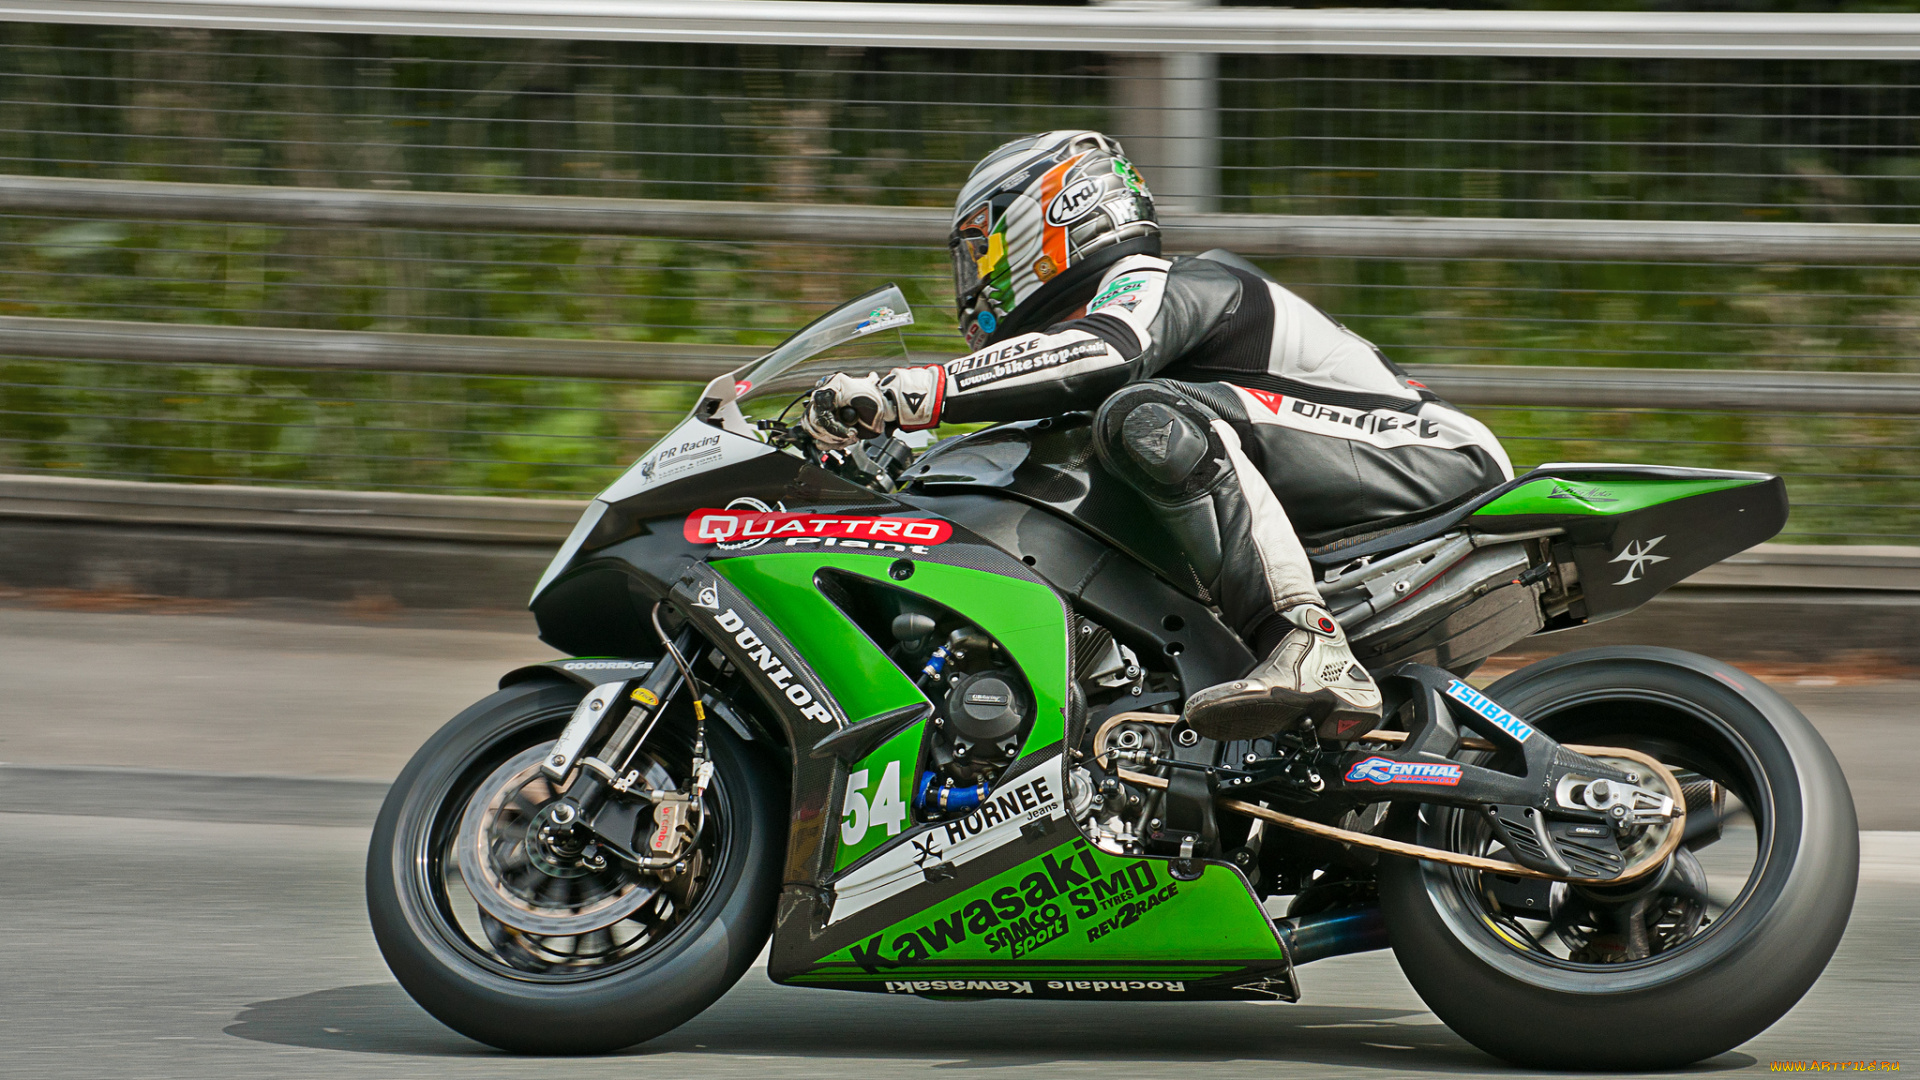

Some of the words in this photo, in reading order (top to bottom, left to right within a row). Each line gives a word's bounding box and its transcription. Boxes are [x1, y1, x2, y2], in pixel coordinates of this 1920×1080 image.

[1057, 180, 1099, 221] Arai
[960, 341, 1105, 387] www.bikestop.co.uk
[659, 447, 677, 460] PR
[680, 435, 721, 453] Racing
[698, 515, 940, 542] QUATTRO
[563, 661, 654, 671] GOODRIDGE
[714, 608, 833, 724] DUNLOP
[1448, 679, 1533, 741] TSUBAKI
[1352, 759, 1460, 781] RENTHAL
[841, 760, 906, 846] 54
[944, 776, 1054, 845] HORNEE
[1027, 802, 1059, 820] Jeans
[849, 839, 1102, 975] Kawasaki
[1068, 860, 1157, 920] SMD
[1099, 889, 1135, 910] TYRES
[984, 904, 1061, 953] SAMCO
[1086, 881, 1179, 943] REV2RACE
[885, 980, 1033, 994] Kawasaki
[1047, 980, 1185, 993] Rochdale
